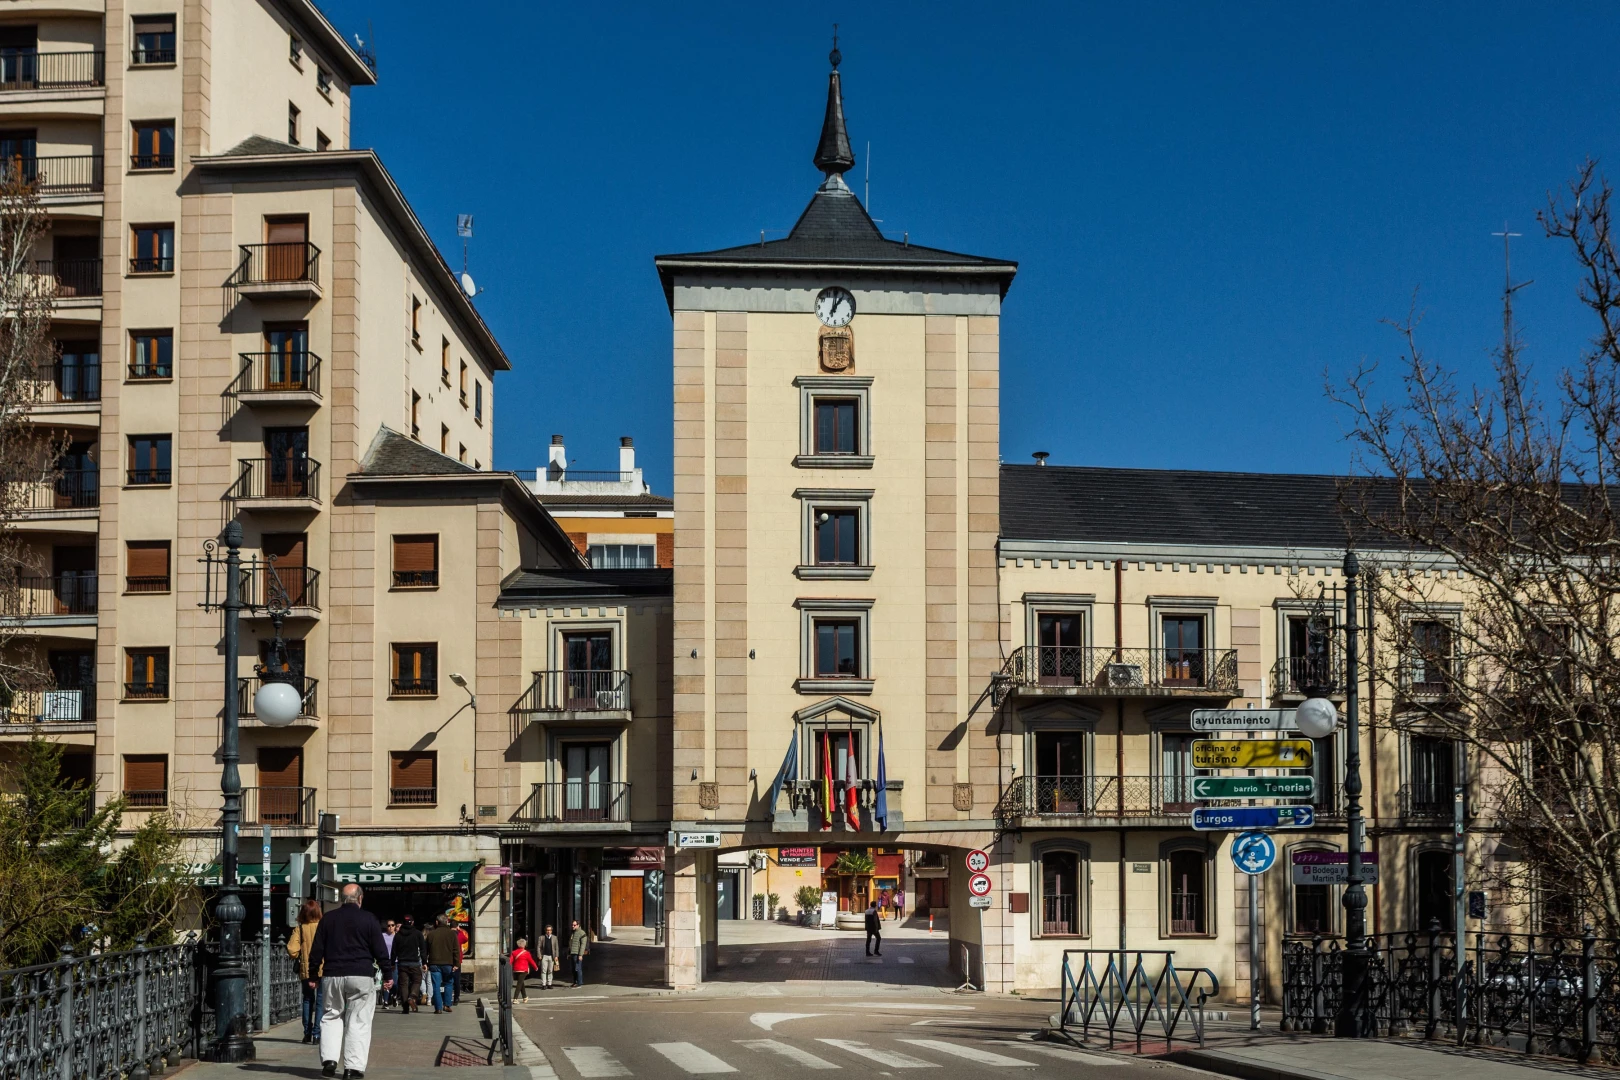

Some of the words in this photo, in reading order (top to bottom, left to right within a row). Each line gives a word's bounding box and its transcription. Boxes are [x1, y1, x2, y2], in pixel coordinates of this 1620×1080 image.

[1195, 714, 1271, 727] ayuntamiento
[1195, 744, 1225, 752] oficina
[1230, 744, 1241, 752] de
[1195, 754, 1238, 763] turismo
[1233, 785, 1258, 793] barrio
[1195, 814, 1234, 825] Burgos
[1312, 866, 1339, 875] Bodega
